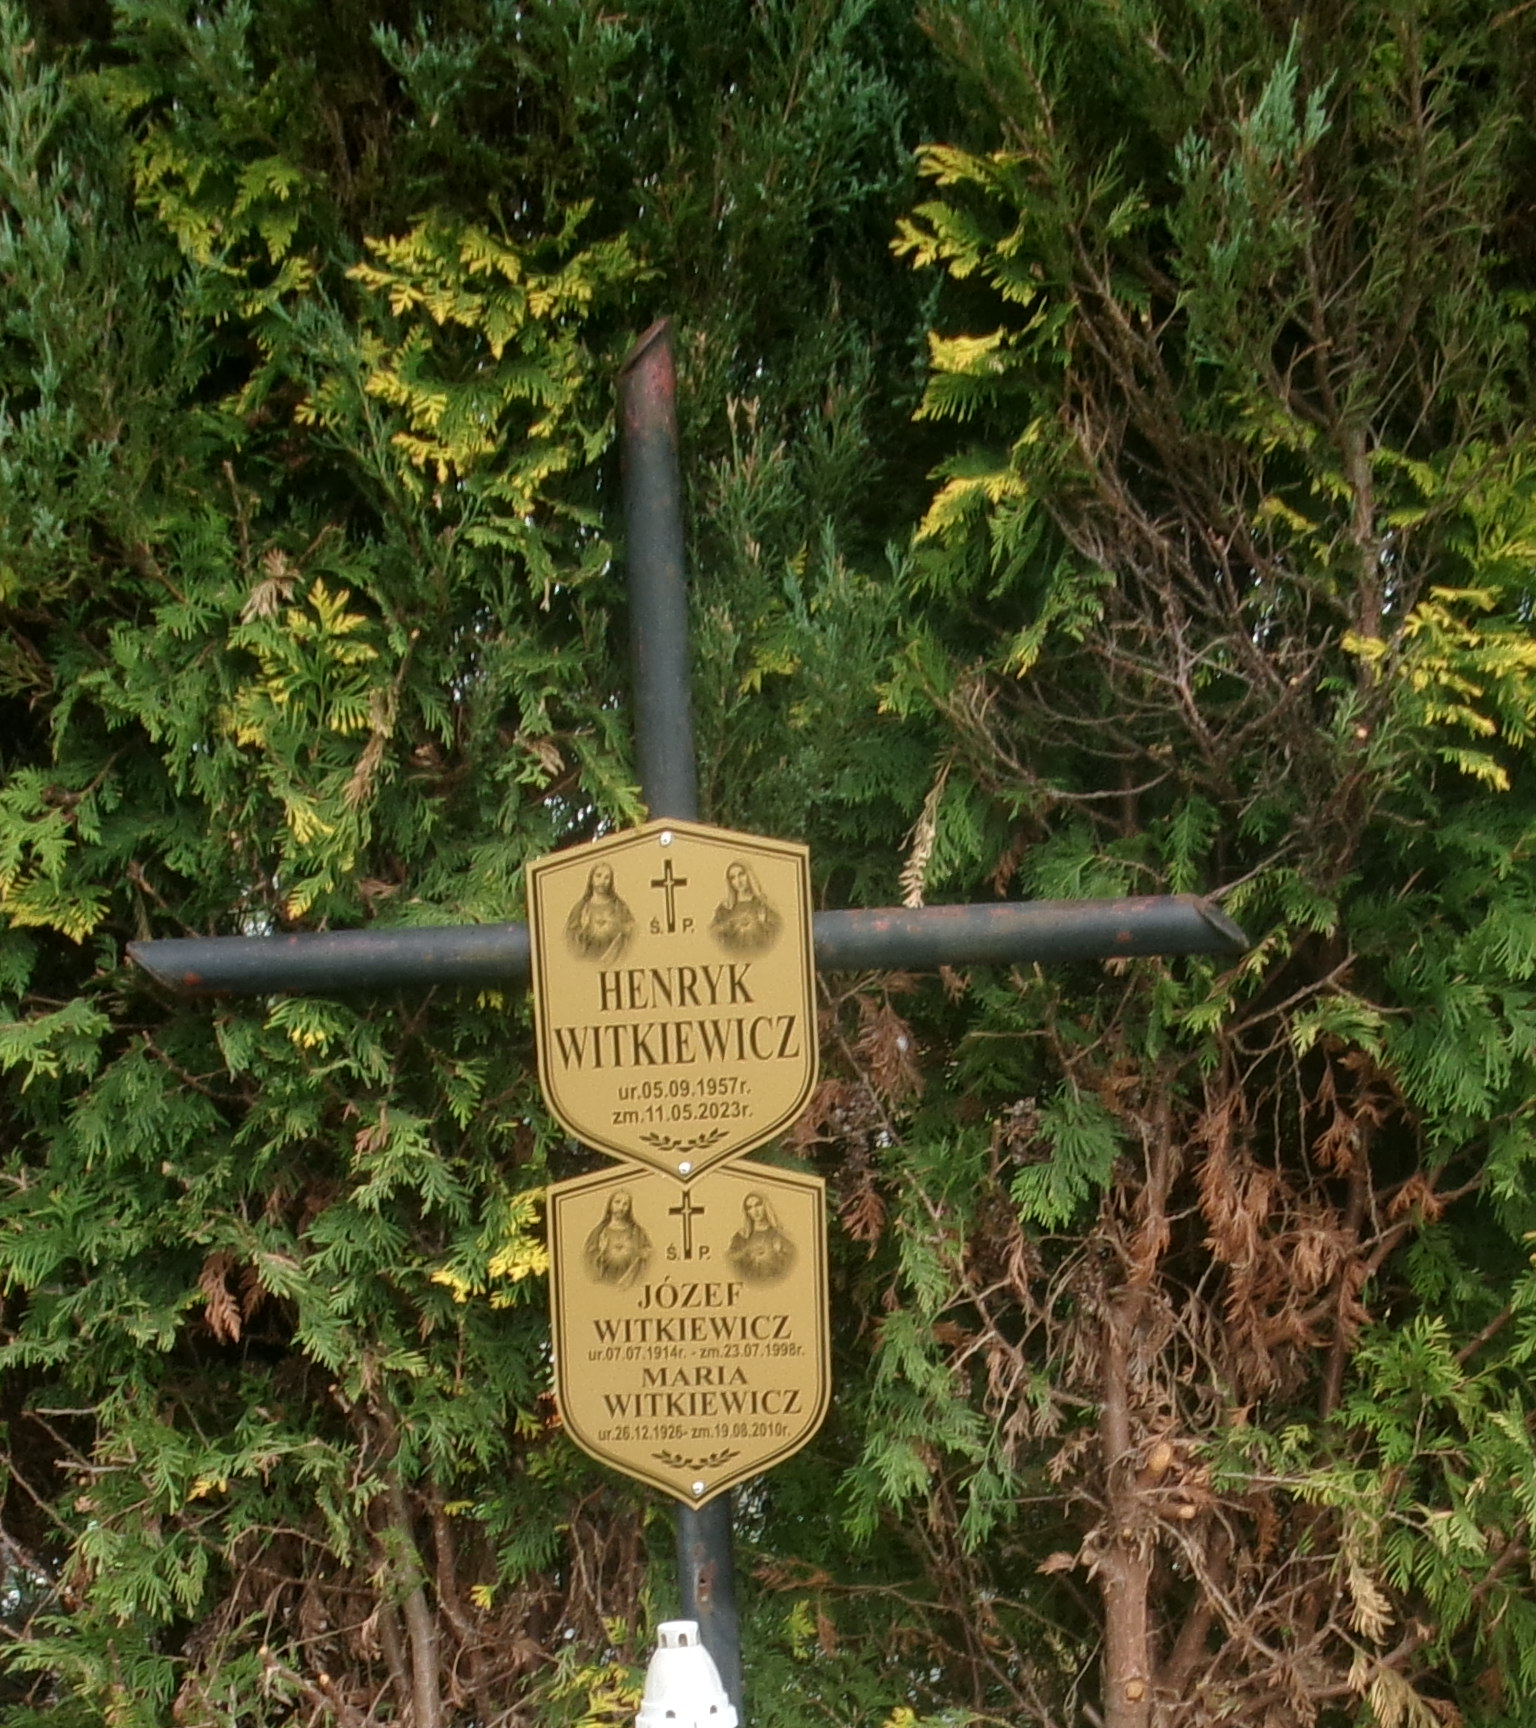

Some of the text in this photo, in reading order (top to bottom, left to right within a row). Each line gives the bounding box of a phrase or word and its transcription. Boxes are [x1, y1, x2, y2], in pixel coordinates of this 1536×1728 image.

[598, 963, 755, 1012] HENRYK
[554, 1015, 801, 1071] WITKIEWICZ
[618, 1077, 752, 1101] ur.05.09.1957r.
[613, 1102, 753, 1125] zm.11.05.2023r.
[638, 1275, 744, 1310] JÓZEF
[593, 1315, 792, 1343] WITKIEWICZ
[588, 1344, 687, 1361] ur.07.07.1914r.
[642, 1366, 749, 1388] MARIA
[603, 1389, 803, 1419] WITKIEWICZ
